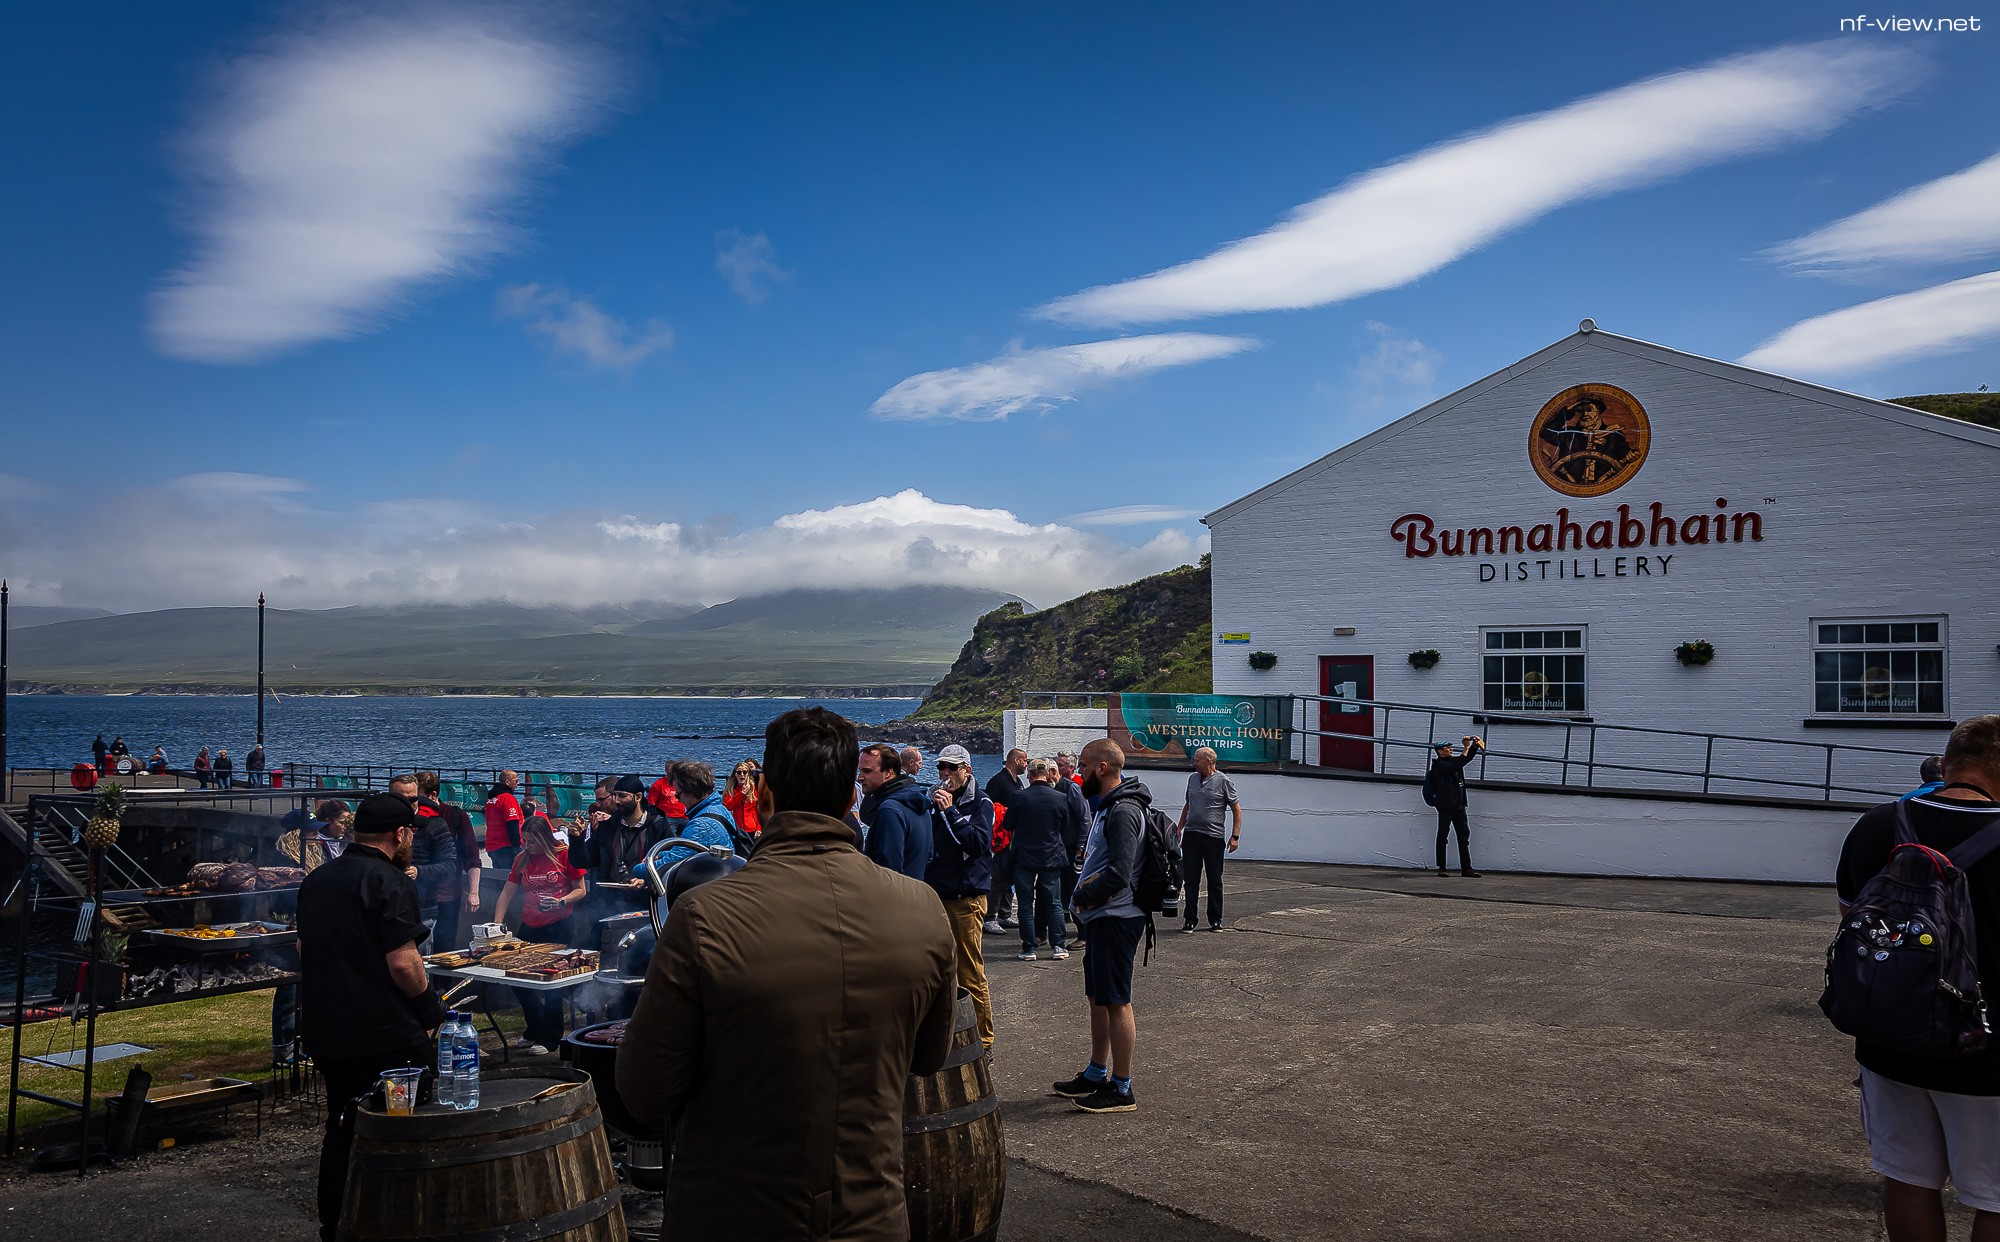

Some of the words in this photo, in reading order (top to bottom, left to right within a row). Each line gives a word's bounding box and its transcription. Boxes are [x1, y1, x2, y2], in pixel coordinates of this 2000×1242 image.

[1391, 497, 1763, 558] Bunnahabhain
[1479, 555, 1673, 582] DISTILLERY
[1175, 704, 1232, 715] Bunnahabhain
[1147, 724, 1232, 737] WESTERING
[1237, 727, 1283, 740] HOME
[1185, 738, 1212, 748] BOAT
[1213, 739, 1244, 749] TRIPS
